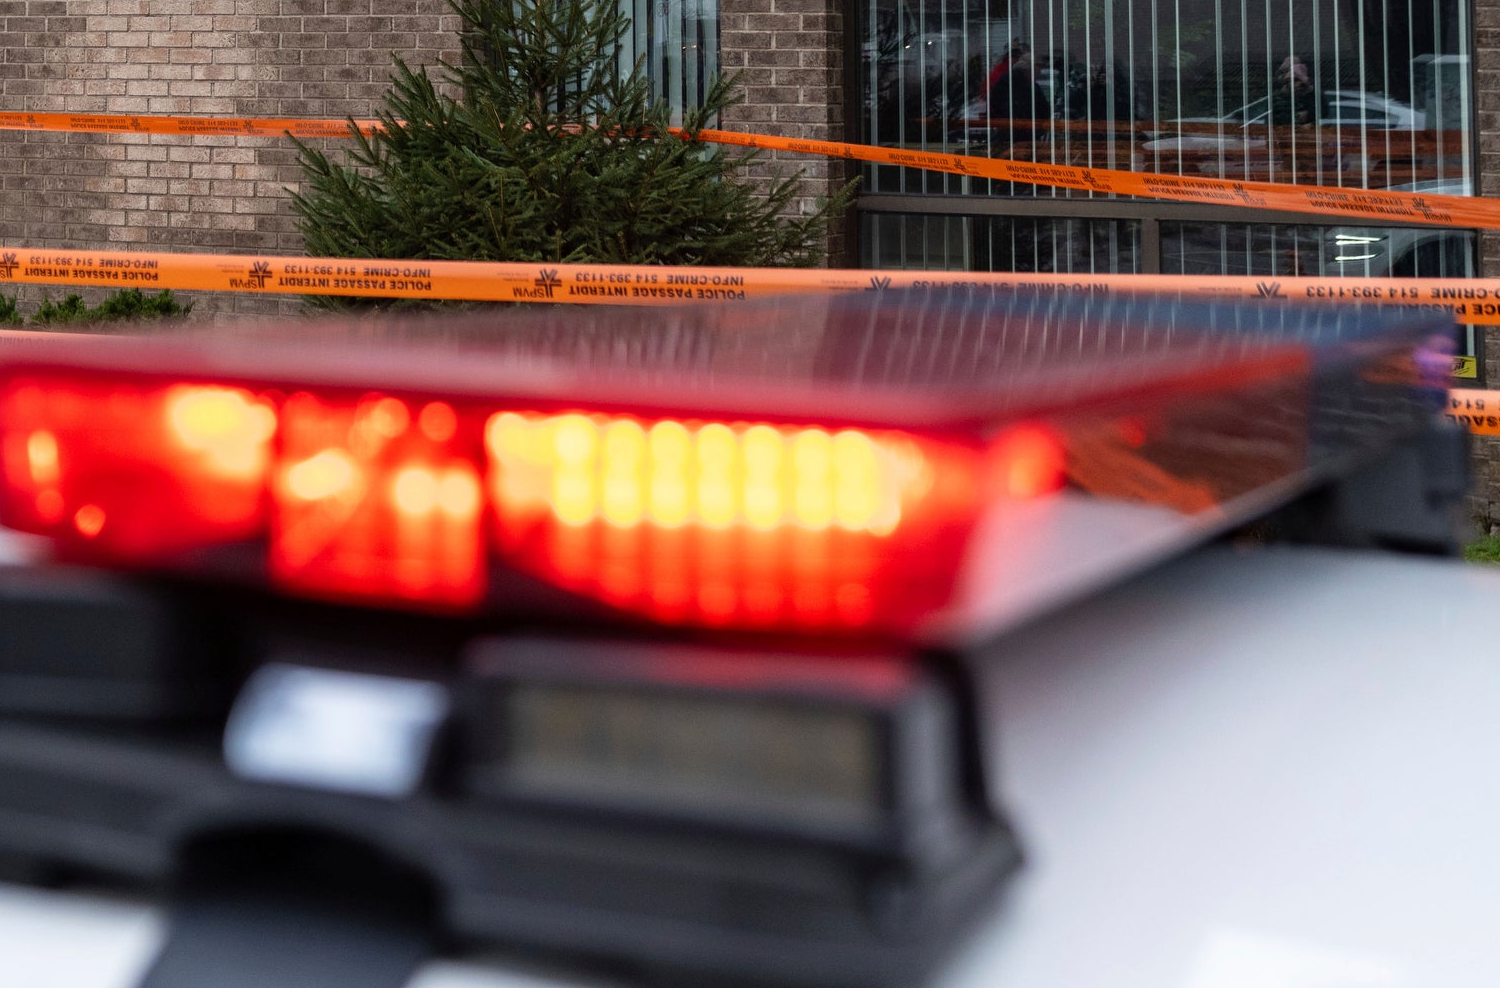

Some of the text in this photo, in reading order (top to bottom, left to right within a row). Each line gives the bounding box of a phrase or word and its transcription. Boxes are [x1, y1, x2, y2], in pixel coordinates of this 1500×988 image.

[30, 256, 158, 269] INFO-CRIME 514 393-1133
[24, 267, 158, 281] POLICE PASSAGE INTERDIT
[284, 265, 431, 278] INFO-CRIME 514 393-1133
[278, 276, 431, 291] POLICE PASSAGE INTERDIT
[575, 272, 744, 286] INFO-CRIME 514 393-1133
[569, 285, 746, 300] POLICE PASSAGE INTERDIT
[1306, 286, 1381, 298] 393-1133
[1389, 287, 1418, 298] 514
